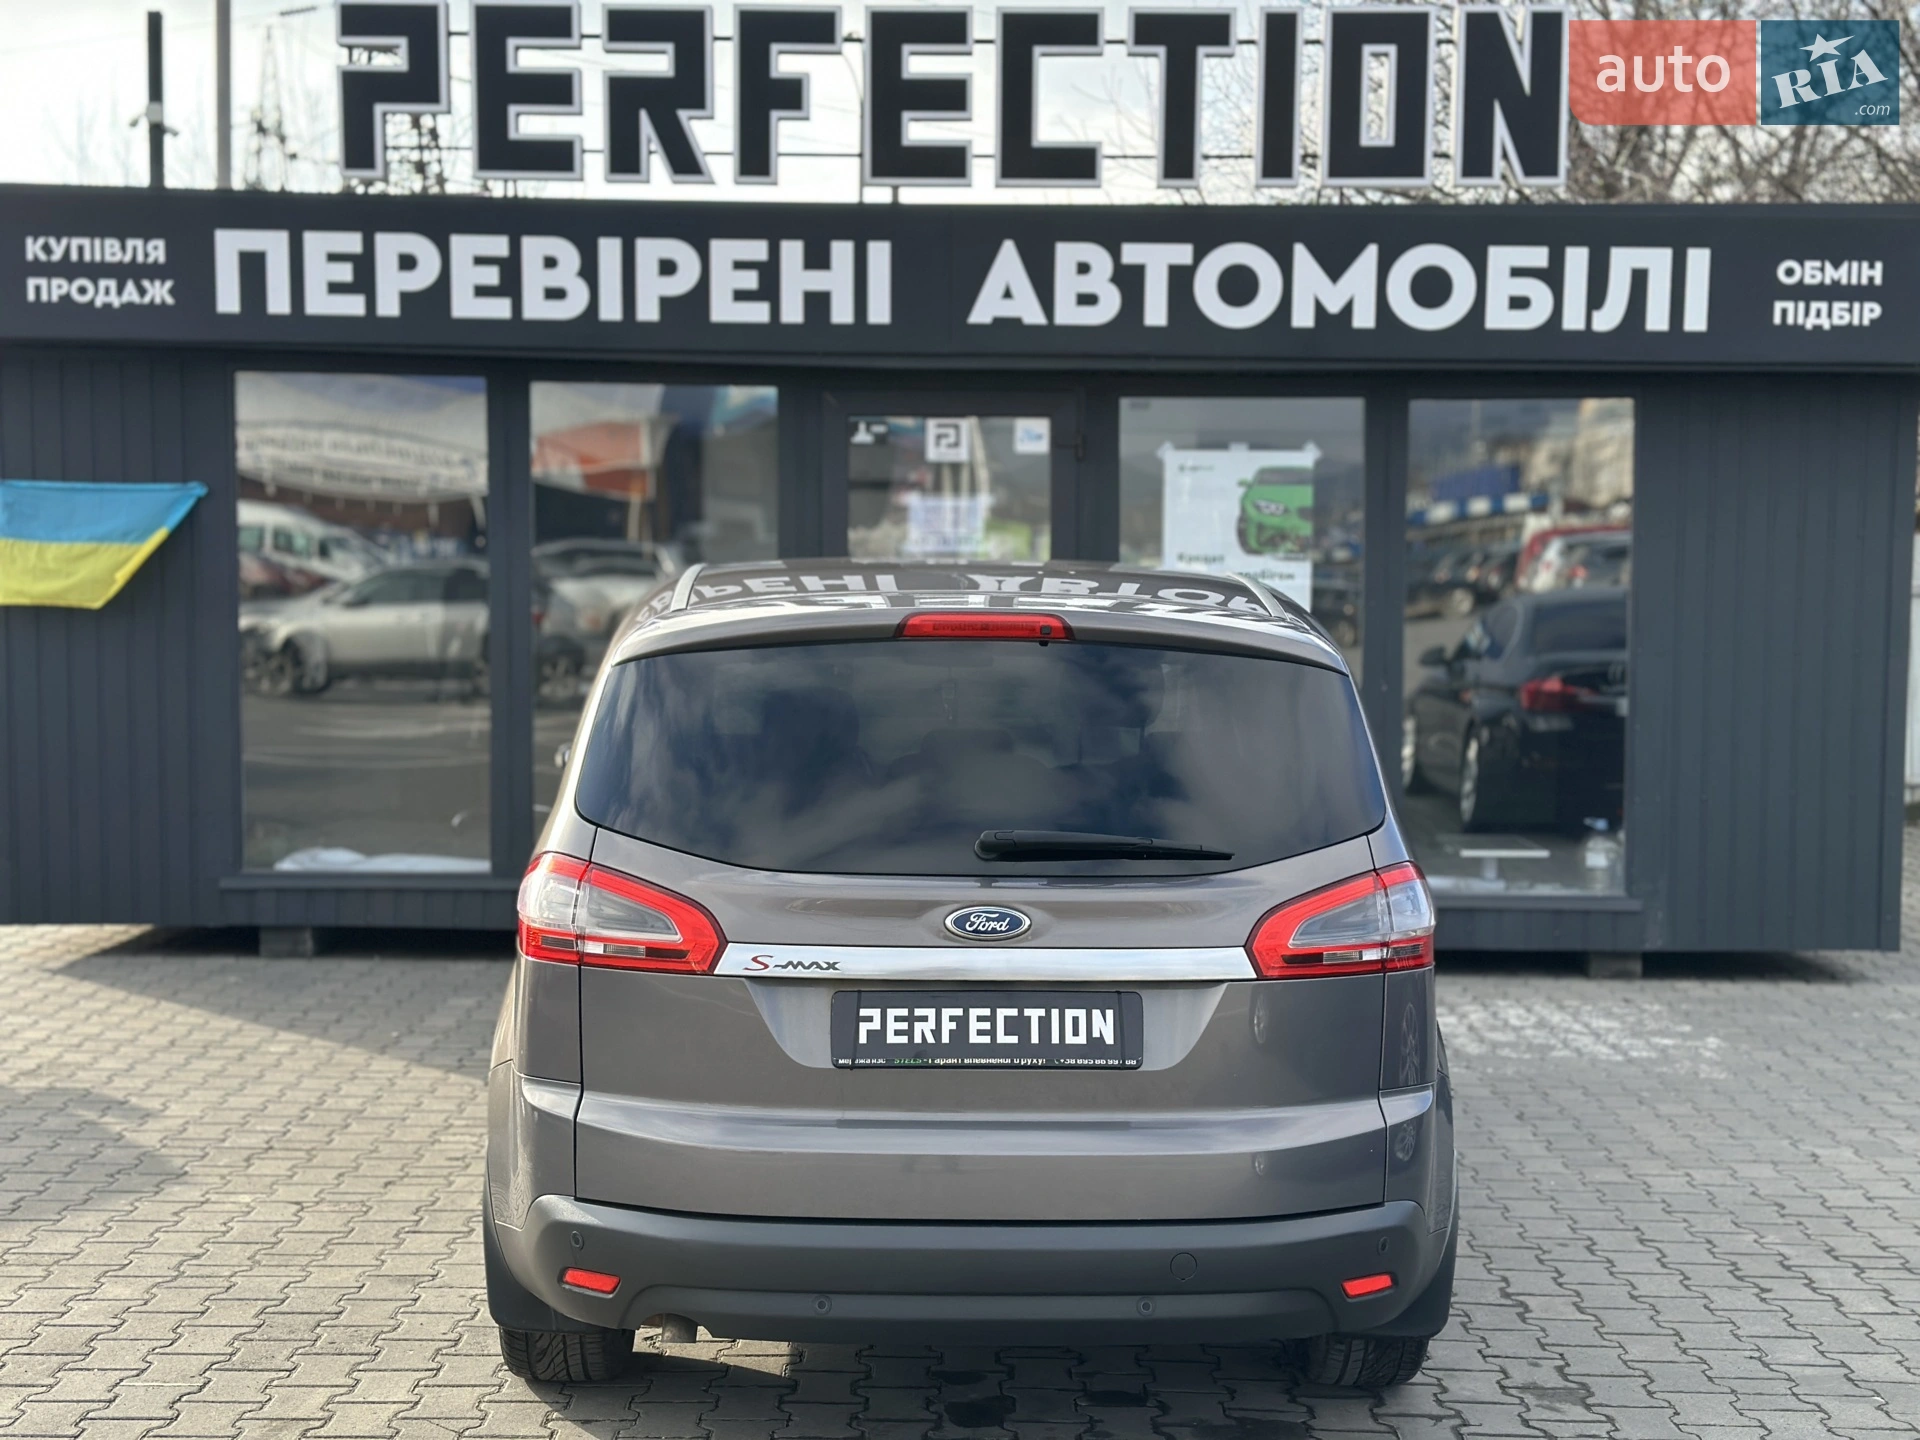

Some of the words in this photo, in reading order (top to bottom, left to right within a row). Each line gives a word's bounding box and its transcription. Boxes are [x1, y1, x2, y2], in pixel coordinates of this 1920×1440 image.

[336, 0, 1569, 188] PERFECTION
[25, 236, 167, 265] КУПІВЛЯ
[213, 228, 892, 325] ПЕРЕВІРЕНІ
[966, 239, 1712, 334] АВТОМОБІЛІ
[1776, 259, 1884, 286] ОБМІН
[25, 277, 175, 308] ПРОДАЖ
[1773, 300, 1882, 330] ПІДБІР
[965, 911, 1010, 932] Ford
[744, 954, 841, 972] S-MAX
[858, 1007, 1114, 1045] PERFECTION
